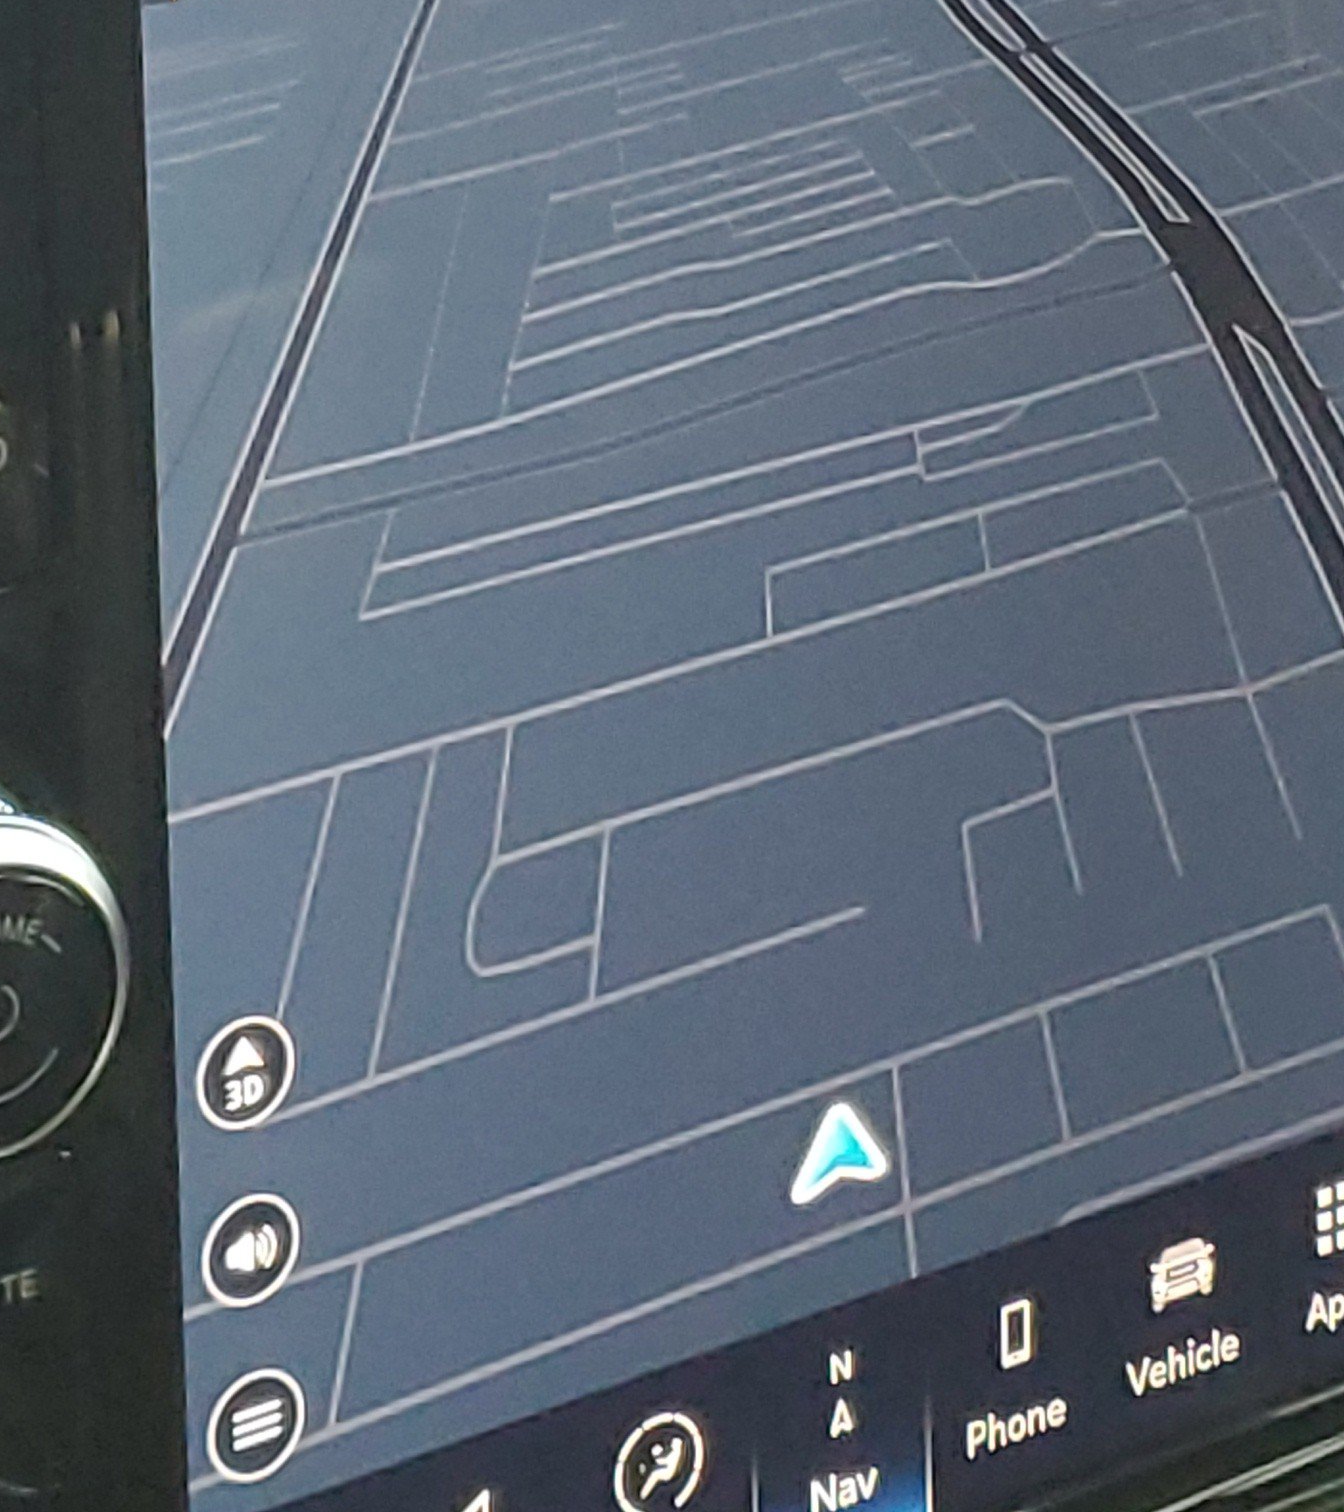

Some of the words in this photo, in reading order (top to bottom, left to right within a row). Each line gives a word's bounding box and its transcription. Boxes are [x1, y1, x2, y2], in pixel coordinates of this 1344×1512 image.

[224, 1075, 265, 1112] 3D
[1126, 1330, 1240, 1397] Vehicle
[966, 1398, 1068, 1461] Phone
[810, 1466, 878, 1511] Nav
